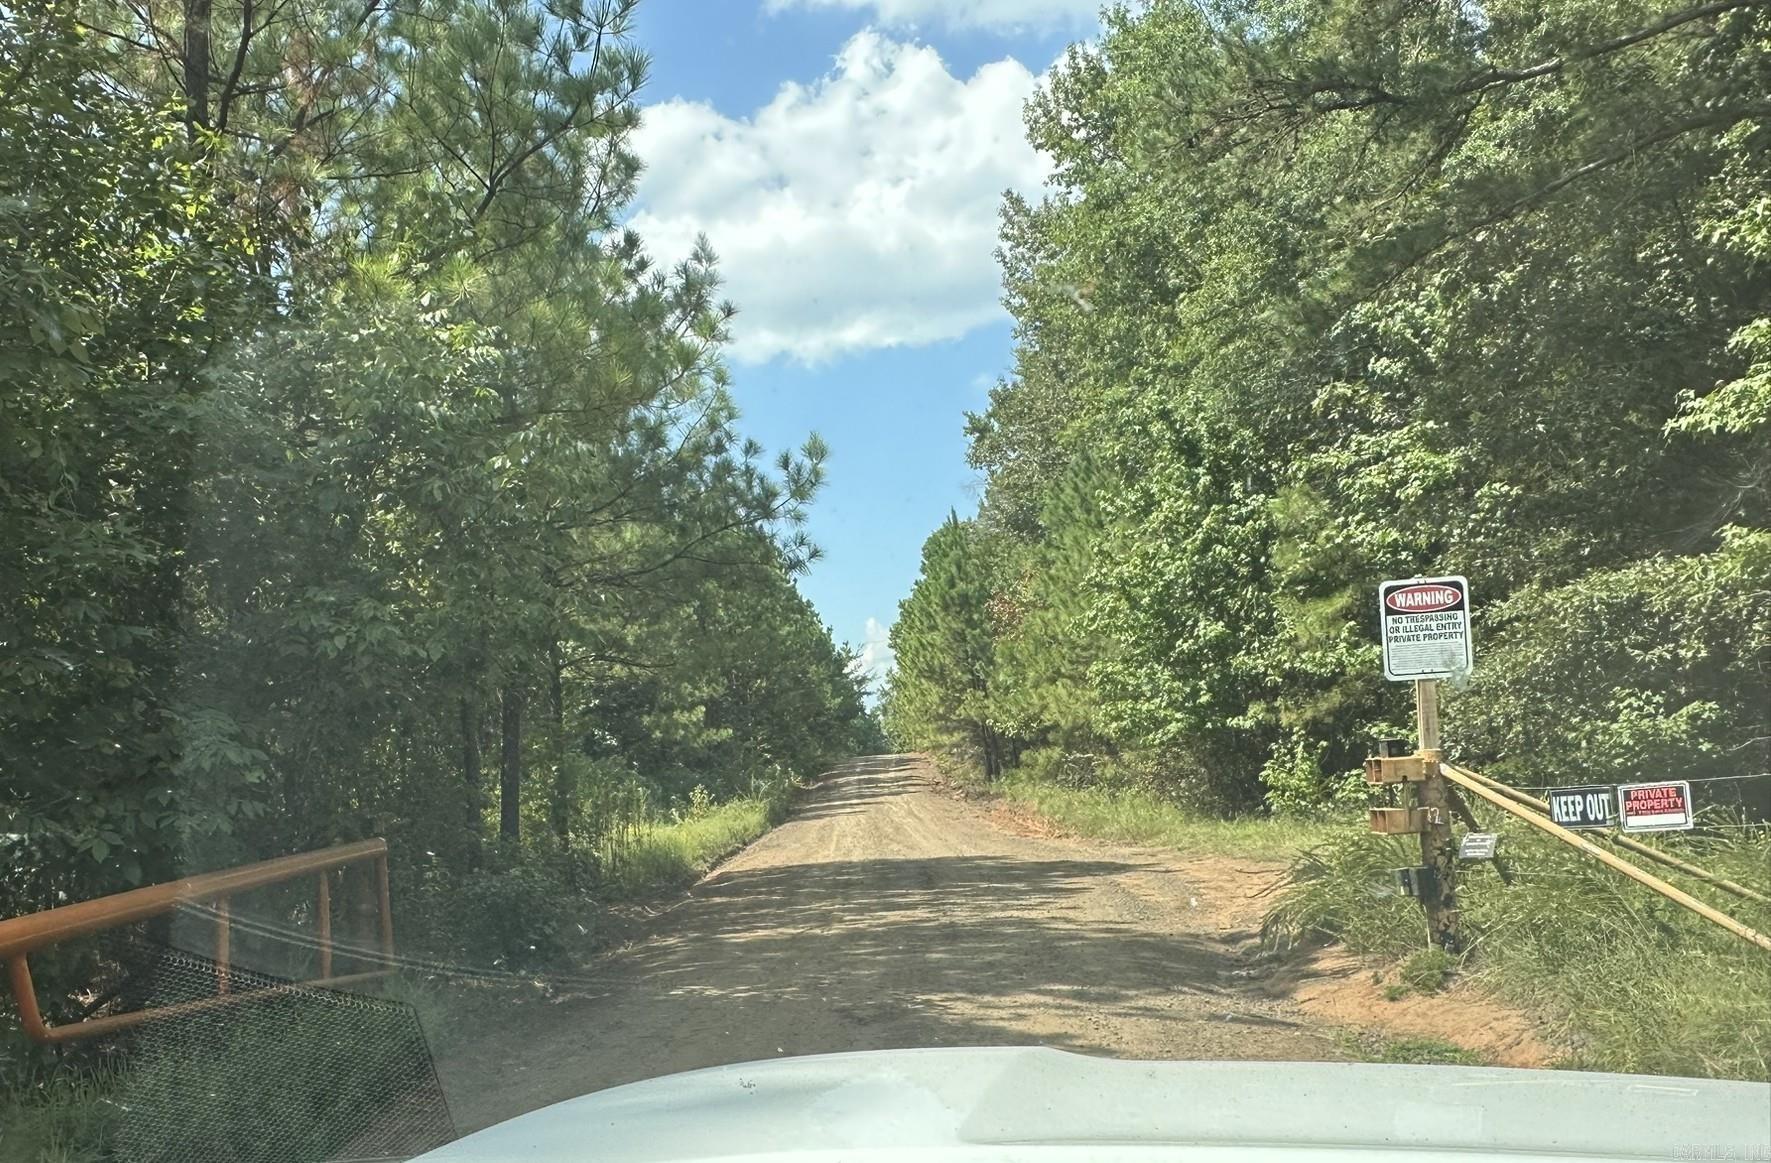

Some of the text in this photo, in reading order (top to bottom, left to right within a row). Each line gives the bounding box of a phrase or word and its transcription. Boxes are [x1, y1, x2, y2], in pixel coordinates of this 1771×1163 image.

[1394, 590, 1454, 608] WARNING
[1392, 613, 1458, 625] NO TRESPASSING
[1389, 621, 1462, 634] OR ILLEGAL ENTRY
[1388, 631, 1464, 643] PRIVATE PROPERTY
[1630, 788, 1677, 800] PRIVATE
[1553, 793, 1610, 822] KEEP OUT
[1625, 797, 1682, 811] PROPERTY
